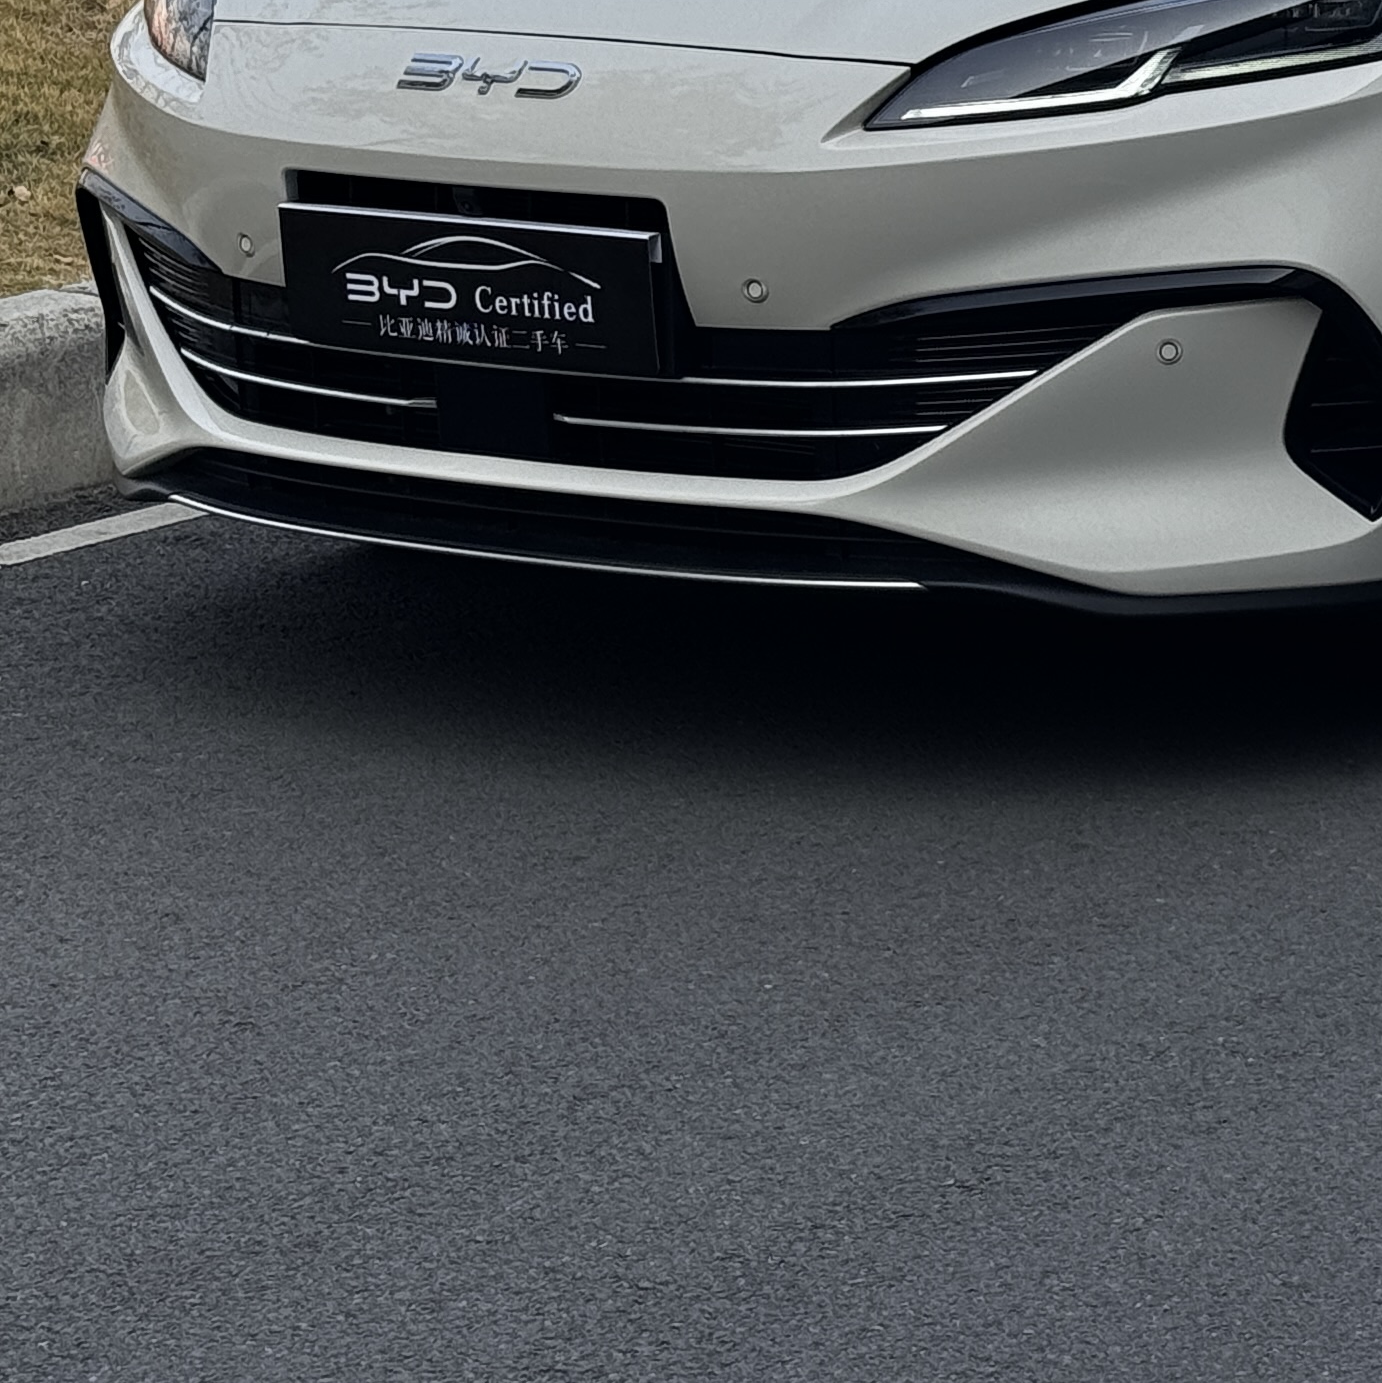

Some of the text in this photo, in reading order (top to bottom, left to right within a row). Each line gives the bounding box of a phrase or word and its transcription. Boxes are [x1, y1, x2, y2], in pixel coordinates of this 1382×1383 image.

[396, 52, 582, 100] BYD
[345, 272, 595, 324] BYD Certified
[379, 314, 569, 355] 比亚迪精诚认证二手车
